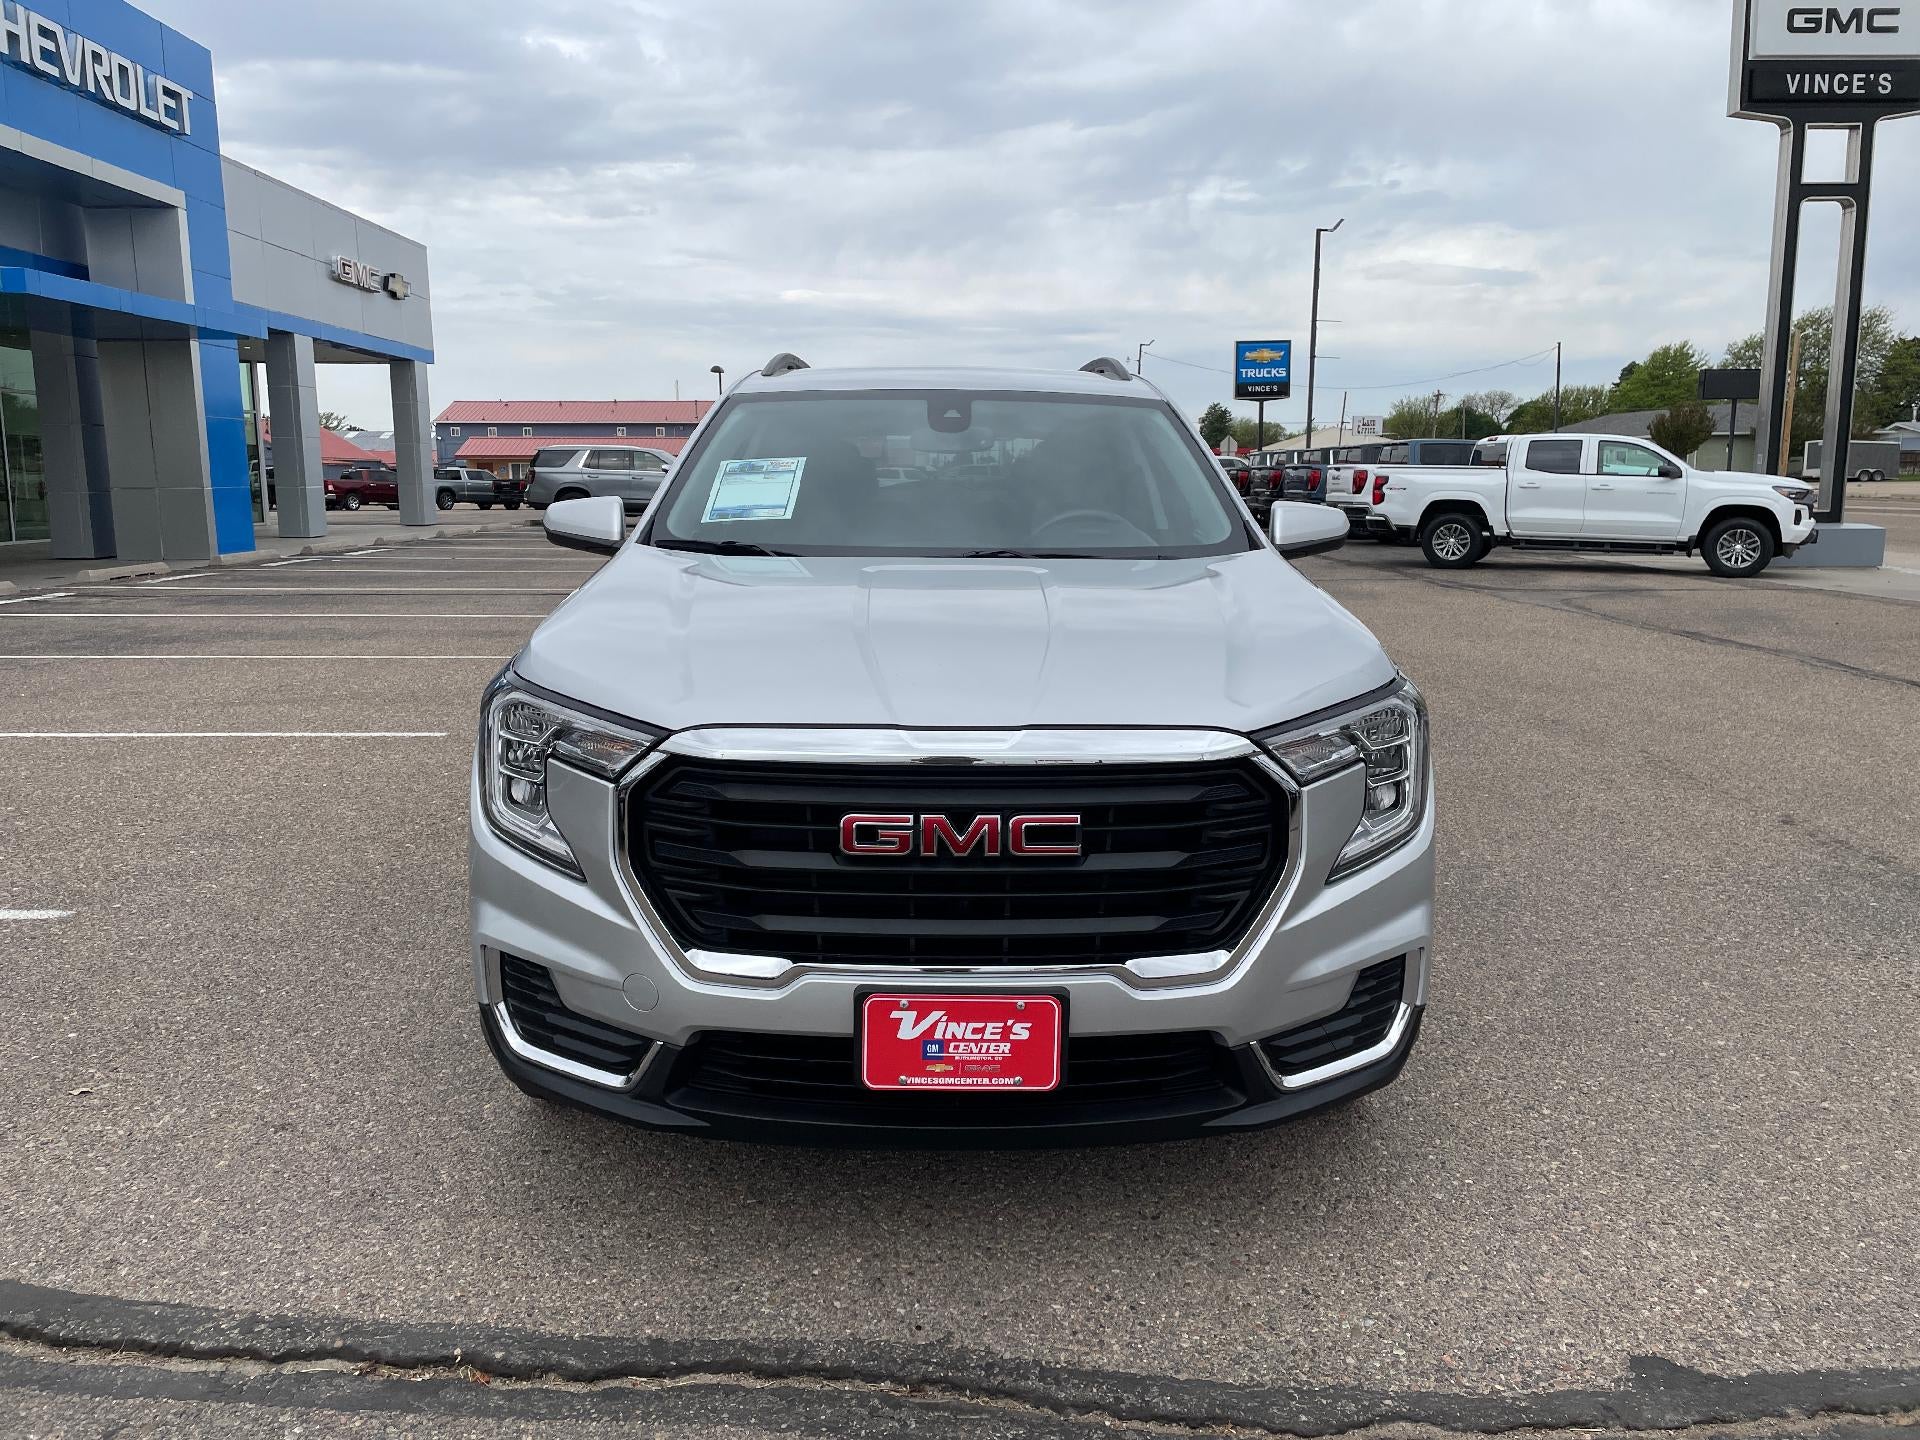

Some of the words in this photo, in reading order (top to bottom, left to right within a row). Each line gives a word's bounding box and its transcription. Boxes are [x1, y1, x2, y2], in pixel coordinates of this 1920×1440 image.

[1786, 7, 1901, 34] GMC
[1786, 73, 1892, 95] VINCE'S
[332, 255, 382, 294] GMC
[1240, 367, 1287, 378] TRUCKS
[839, 814, 1081, 857] GMC
[926, 1043, 939, 1053] GM
[948, 1042, 1012, 1054] CENTER
